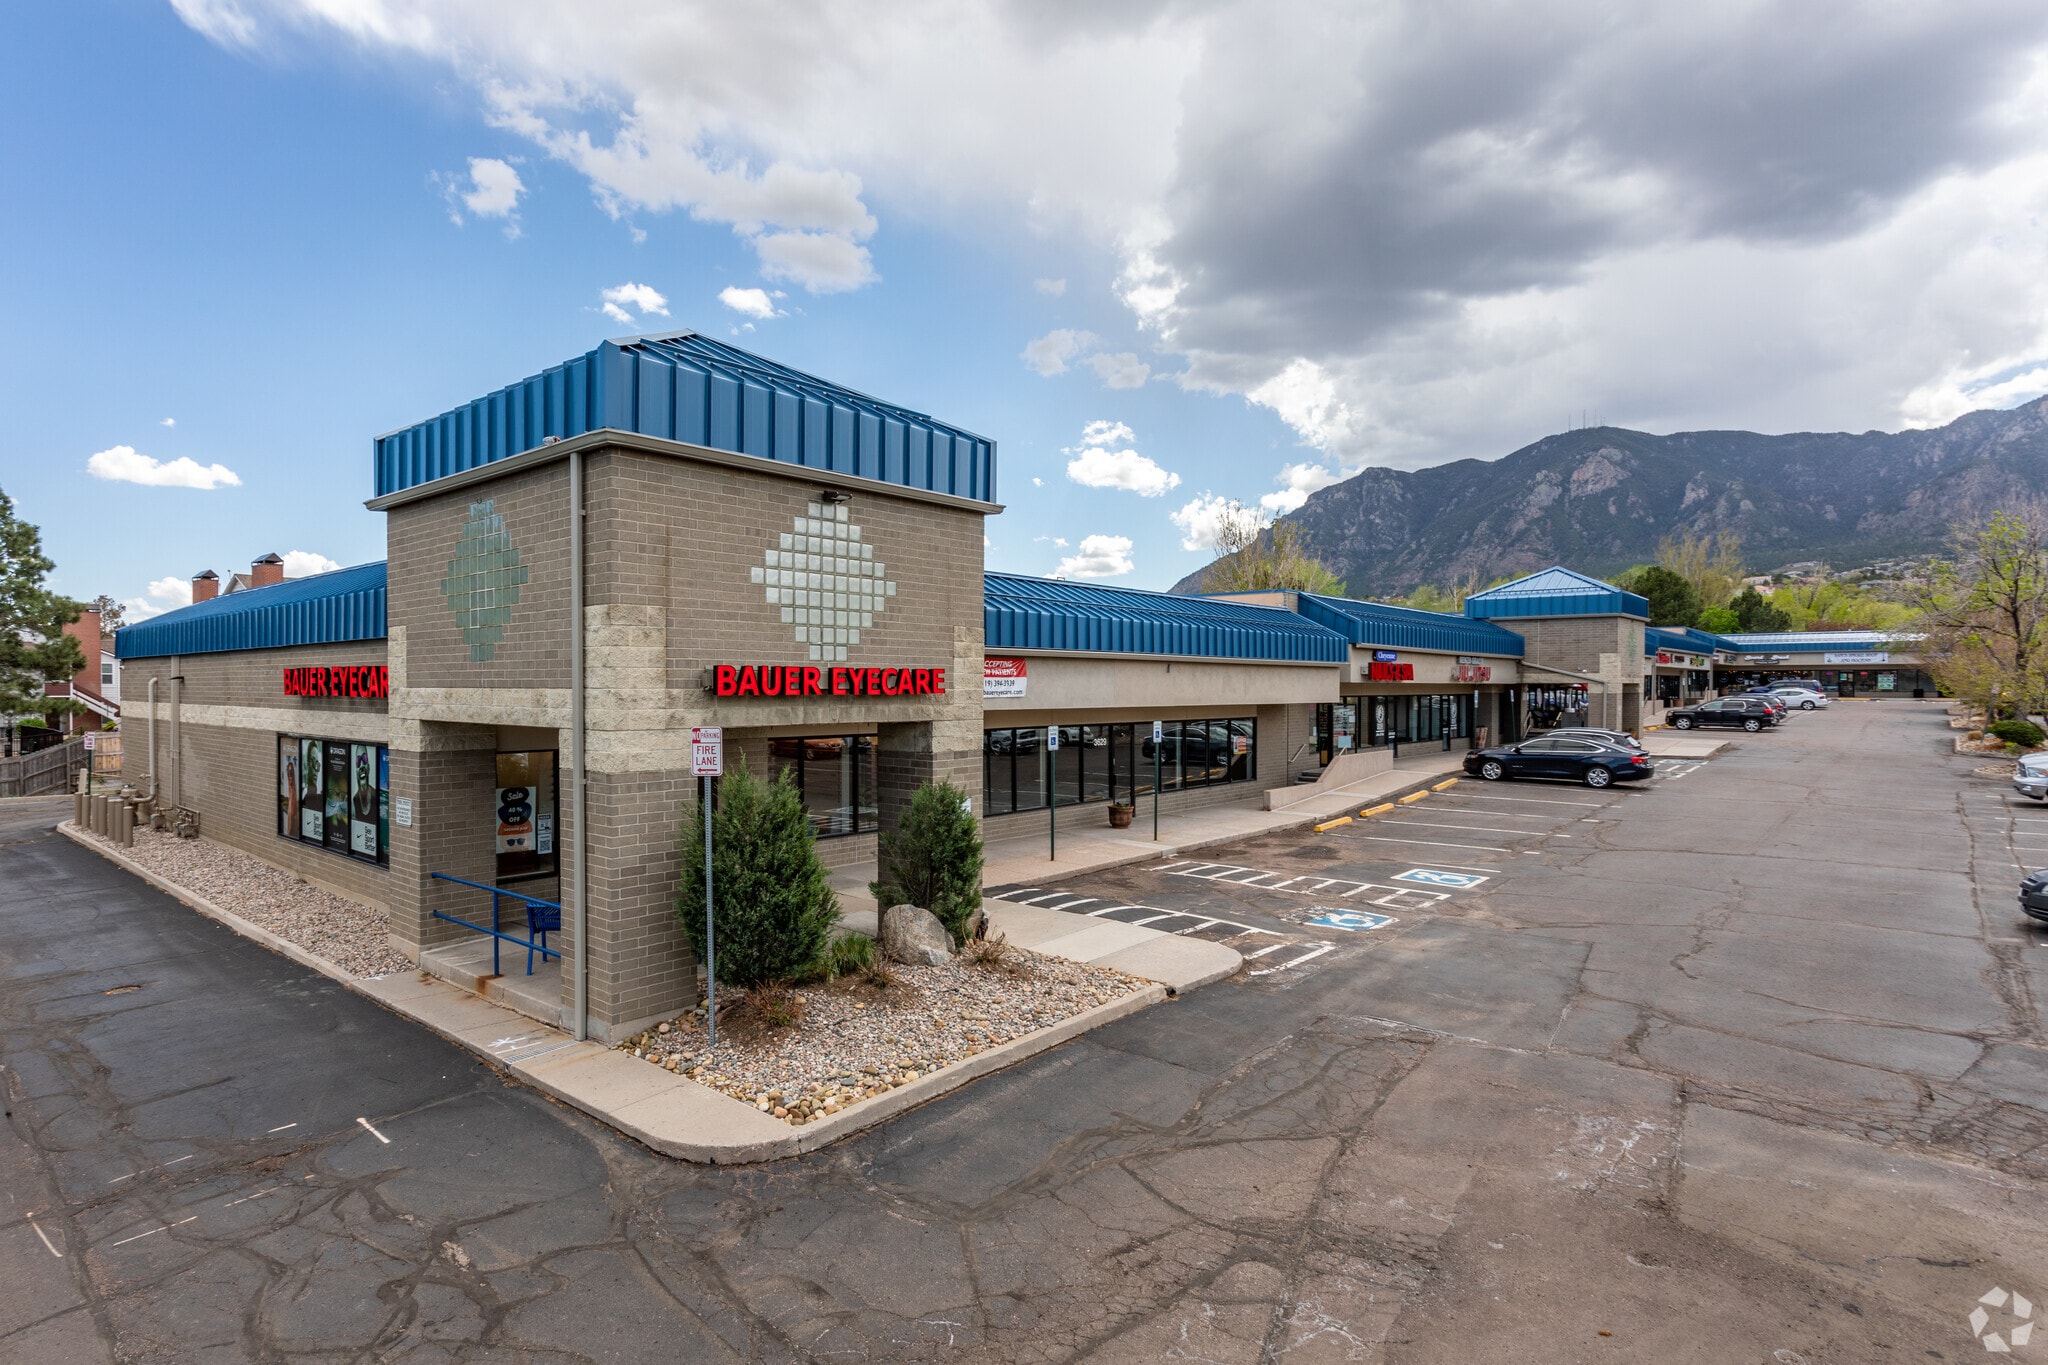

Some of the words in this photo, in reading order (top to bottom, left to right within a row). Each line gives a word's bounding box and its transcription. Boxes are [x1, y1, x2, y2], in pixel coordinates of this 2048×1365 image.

[283, 667, 328, 697] BAUER
[331, 665, 389, 698] EYECAR
[716, 665, 823, 697] BAUER
[832, 667, 946, 695] EYECARE
[692, 731, 700, 740] NO
[697, 746, 716, 754] FIRE
[696, 757, 717, 765] LANE
[507, 792, 524, 800] Sale
